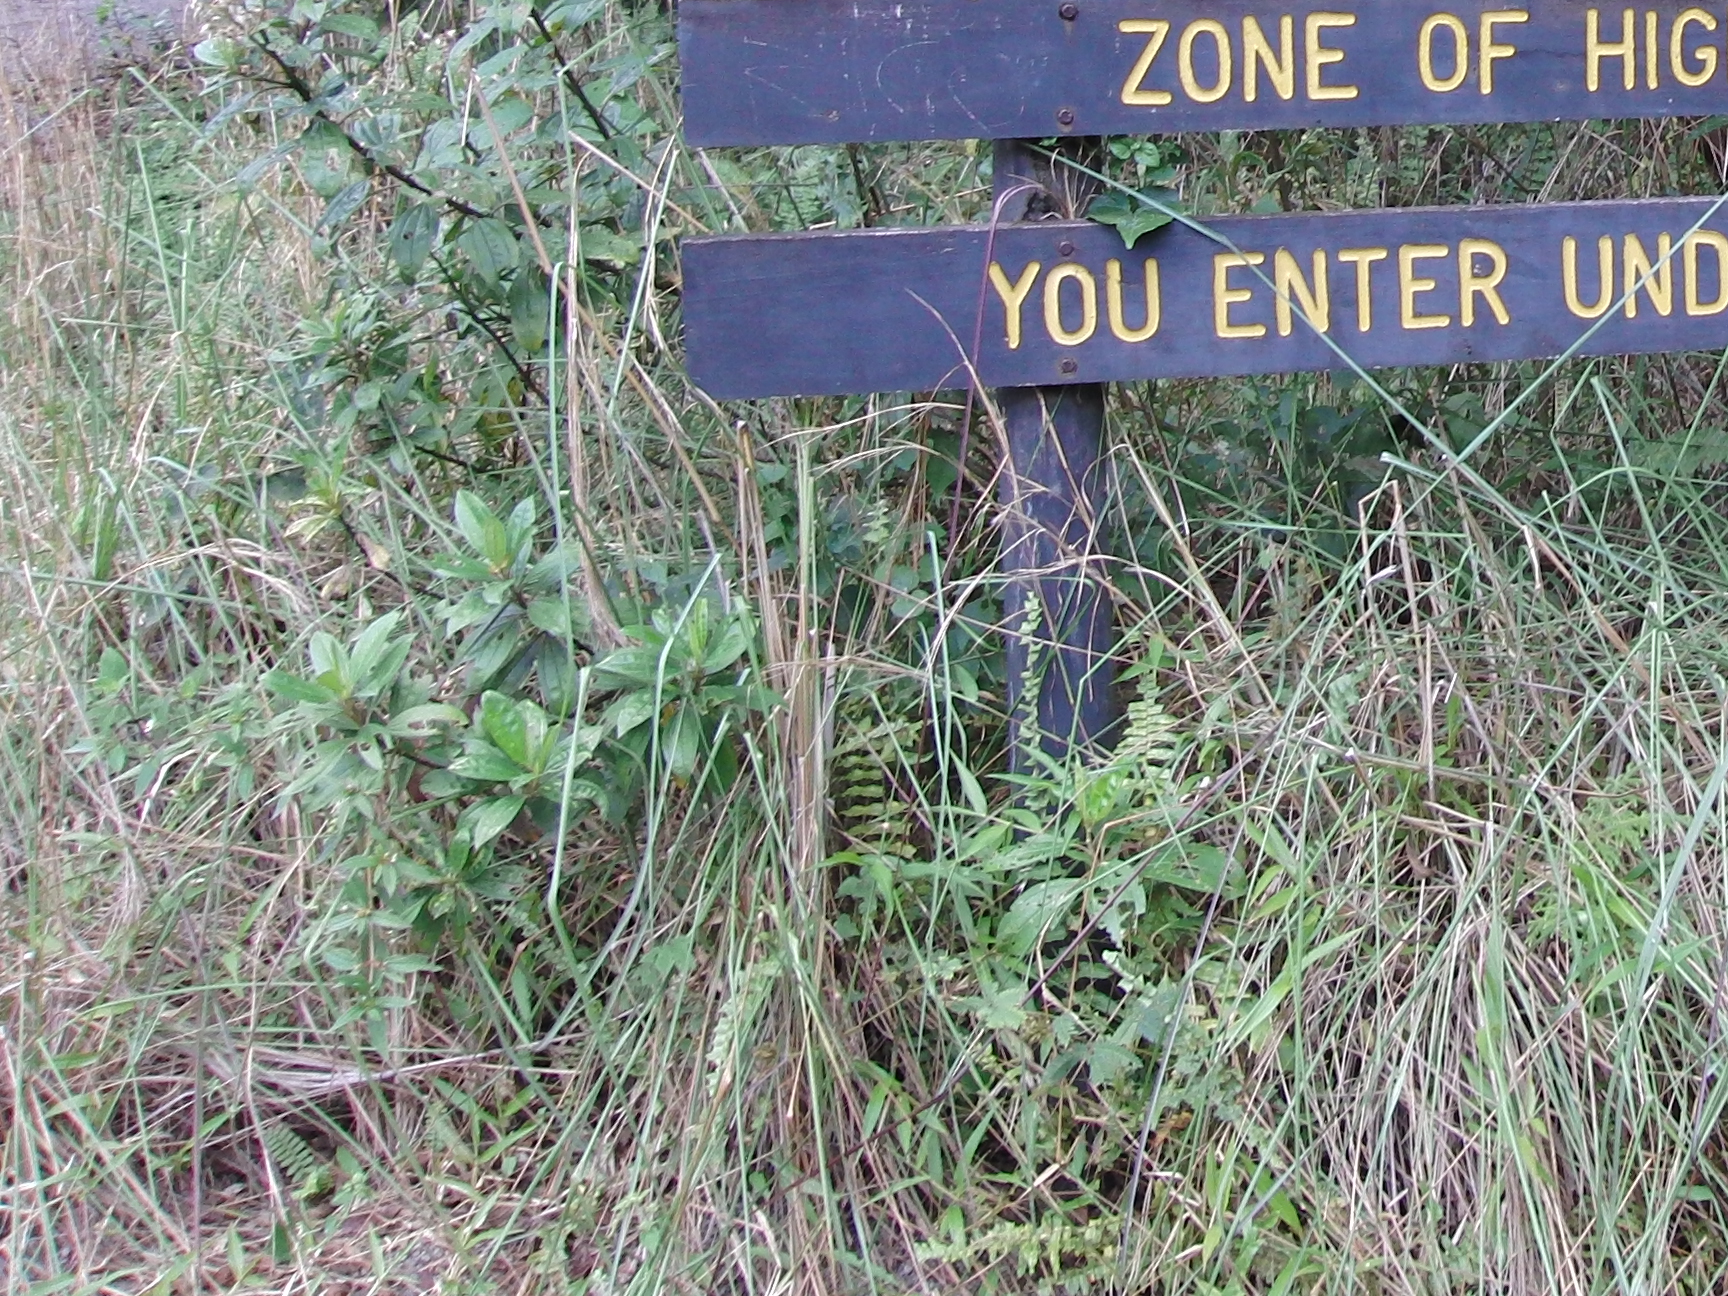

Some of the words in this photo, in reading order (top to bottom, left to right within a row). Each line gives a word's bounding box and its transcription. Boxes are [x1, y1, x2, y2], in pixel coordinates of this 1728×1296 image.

[1118, 11, 1359, 105] ZONE
[1418, 8, 1530, 92] OF
[988, 257, 1161, 347] YOU
[1213, 241, 1510, 337] ENTER
